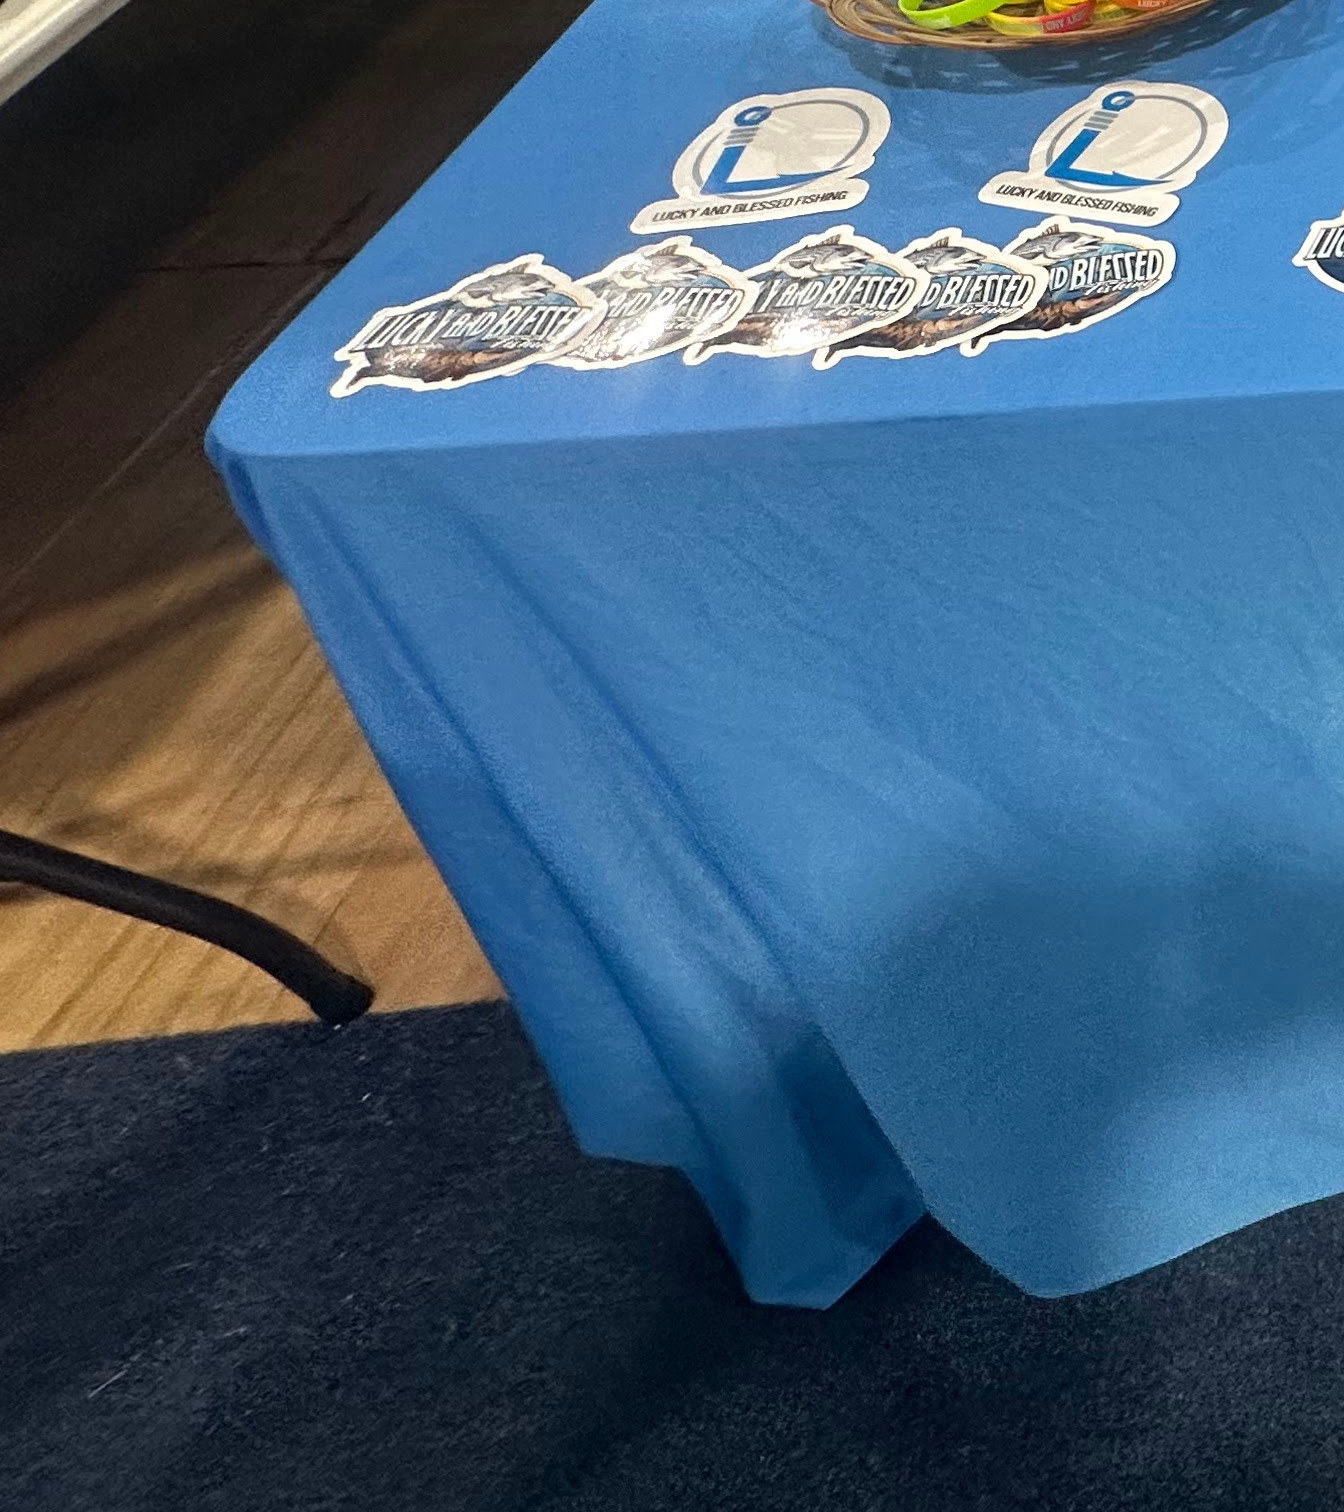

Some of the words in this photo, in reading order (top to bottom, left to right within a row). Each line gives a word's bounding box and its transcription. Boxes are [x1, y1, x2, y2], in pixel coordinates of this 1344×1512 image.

[652, 209, 700, 223] LUCKY
[700, 205, 730, 218] AND
[733, 198, 793, 215] BLESSED
[795, 190, 848, 207] FISHING
[996, 185, 1035, 198] LUCKY
[1036, 189, 1063, 201] AND
[1062, 192, 1112, 212] BLESSED
[1111, 200, 1156, 217] FISHING
